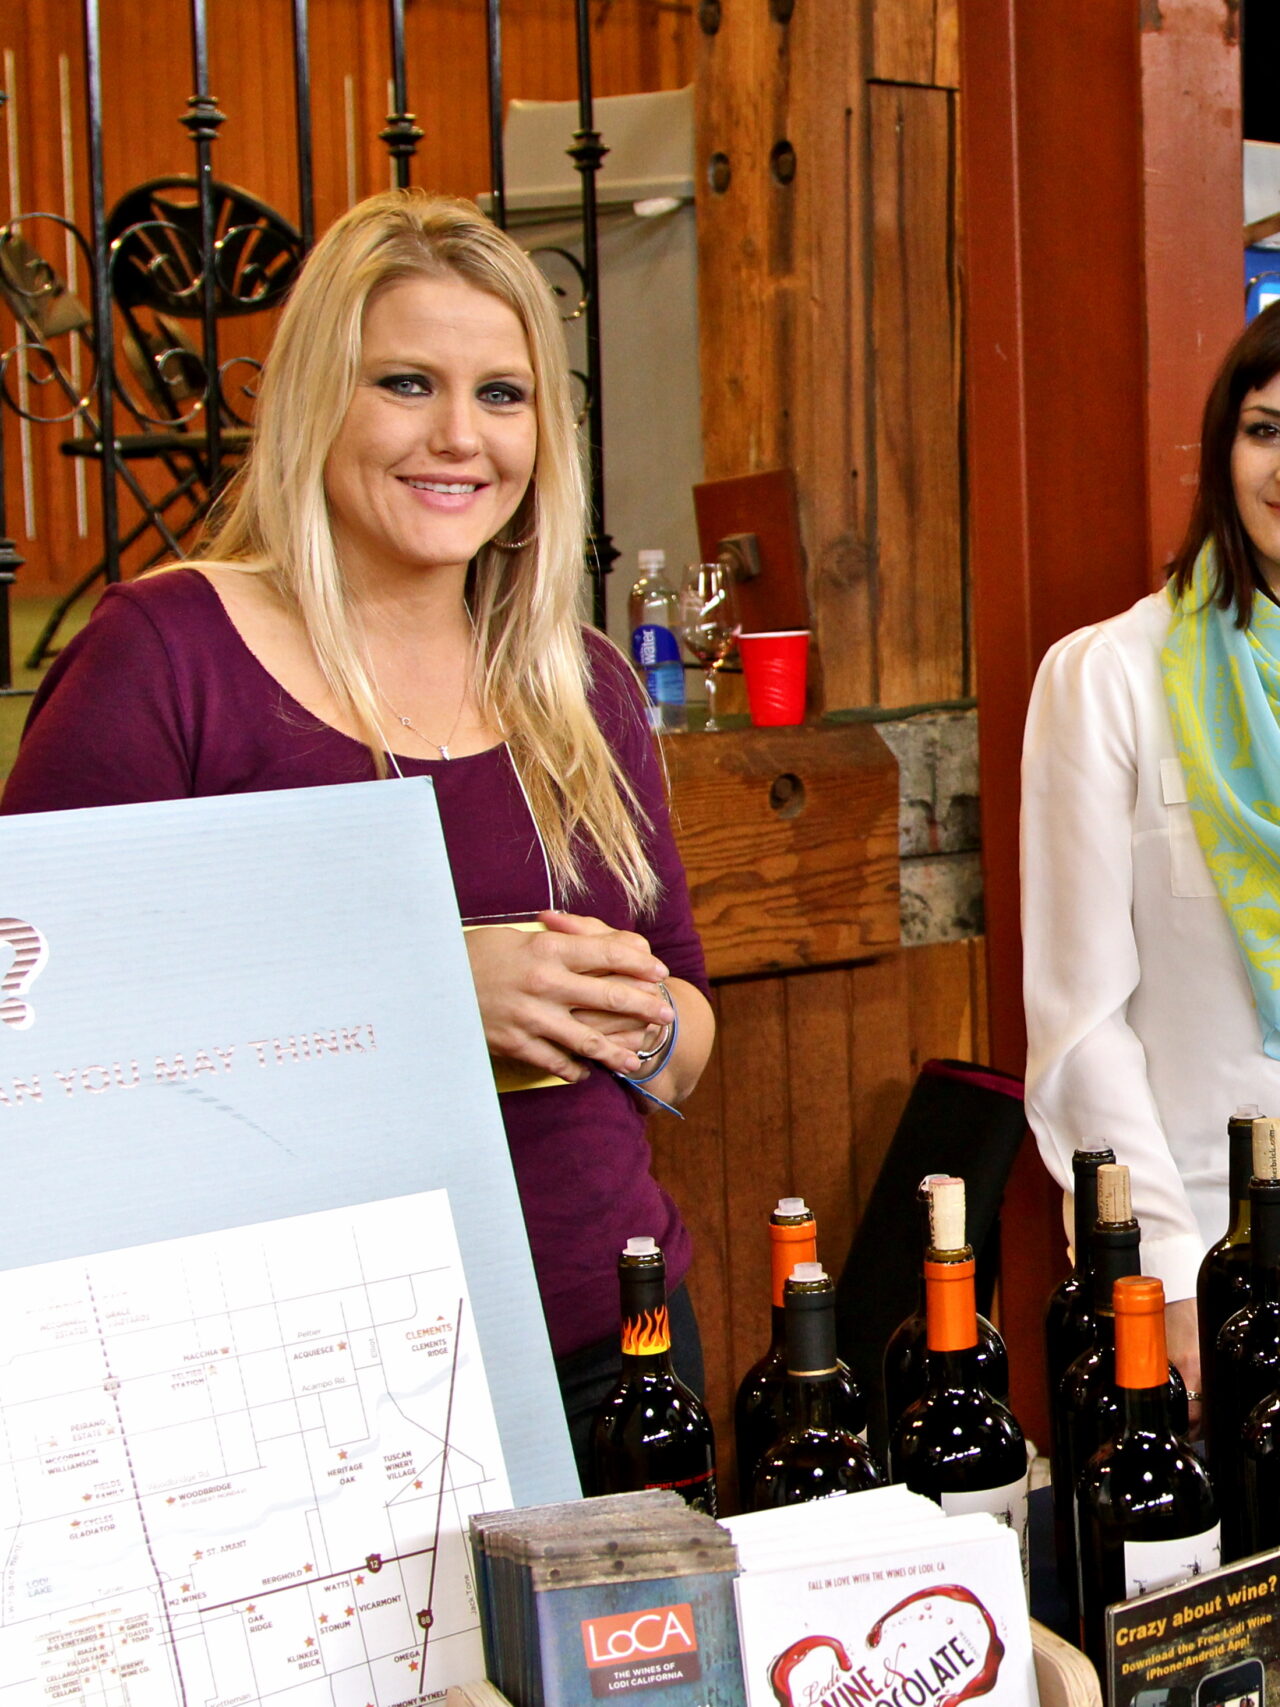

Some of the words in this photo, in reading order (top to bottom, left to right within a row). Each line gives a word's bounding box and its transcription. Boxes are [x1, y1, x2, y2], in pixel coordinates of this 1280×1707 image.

[0, 1073, 43, 1107] AN
[53, 1058, 141, 1098] YOU
[154, 1043, 236, 1084] MAY
[247, 1023, 379, 1068] THINK!
[297, 1328, 322, 1339] Peltier
[405, 1323, 453, 1340] CLEMENTS
[293, 1345, 335, 1360] ACQUIESCE
[411, 1339, 447, 1352] CLEMENTS
[427, 1346, 449, 1358] RIDGE
[183, 1348, 218, 1362] MACCHIA
[302, 1379, 332, 1392] Acampo
[70, 1419, 106, 1432] PEIRANO
[72, 1429, 102, 1442] ESTATE
[383, 1450, 412, 1463] TUSCAN
[47, 1457, 99, 1475] WILLIAMSON
[327, 1463, 363, 1477] HERITAGE
[384, 1459, 413, 1472] WINERY
[340, 1476, 357, 1485] OAK
[386, 1467, 417, 1481] VILLAGE
[94, 1479, 122, 1491] FIELDS
[178, 1482, 232, 1501] WOODBRIDGE
[69, 1524, 116, 1541] GLADIATOR
[369, 1560, 380, 1569] 12
[261, 1569, 303, 1585] BERGHOLD
[808, 1580, 823, 1592] FALL
[824, 1579, 832, 1589] IN
[834, 1577, 851, 1588] LOVE
[852, 1573, 871, 1585] WITH
[872, 1571, 884, 1581] THE
[886, 1568, 907, 1579] WINES
[908, 1566, 917, 1576] OF
[937, 1562, 946, 1571] CA
[27, 1585, 53, 1598] LAKE
[324, 1579, 351, 1593] WATTS
[168, 1596, 180, 1606] M2
[181, 1592, 207, 1604] WINES
[359, 1594, 402, 1612] VICARMONT
[1115, 1617, 1167, 1647] Crazy
[1172, 1596, 1222, 1627] about
[1226, 1575, 1278, 1608] wine?
[247, 1614, 265, 1624] OAK
[421, 1615, 431, 1625] 88
[249, 1622, 274, 1634] RIDGE
[320, 1620, 352, 1635] STONUM
[61, 1633, 98, 1648] VINEYARDS
[588, 1610, 693, 1662] LoCA
[1121, 1649, 1175, 1675] Download
[1178, 1641, 1195, 1655] the
[1197, 1632, 1221, 1648] Free
[1222, 1622, 1246, 1640] Lodi
[1247, 1613, 1273, 1630] Wine
[287, 1649, 319, 1664] KLINKER
[394, 1650, 421, 1663] OMEGA
[1146, 1643, 1226, 1682] iPhone/Android
[1226, 1635, 1252, 1653] App!
[298, 1658, 321, 1671] BRICK
[613, 1669, 632, 1680] THE
[633, 1664, 662, 1678] WINES
[663, 1661, 676, 1672] OF
[875, 1636, 975, 1707] OCOLATE
[608, 1678, 630, 1691] LODI
[630, 1670, 684, 1688] CALIFORNIA
[802, 1665, 842, 1707] Lodi
